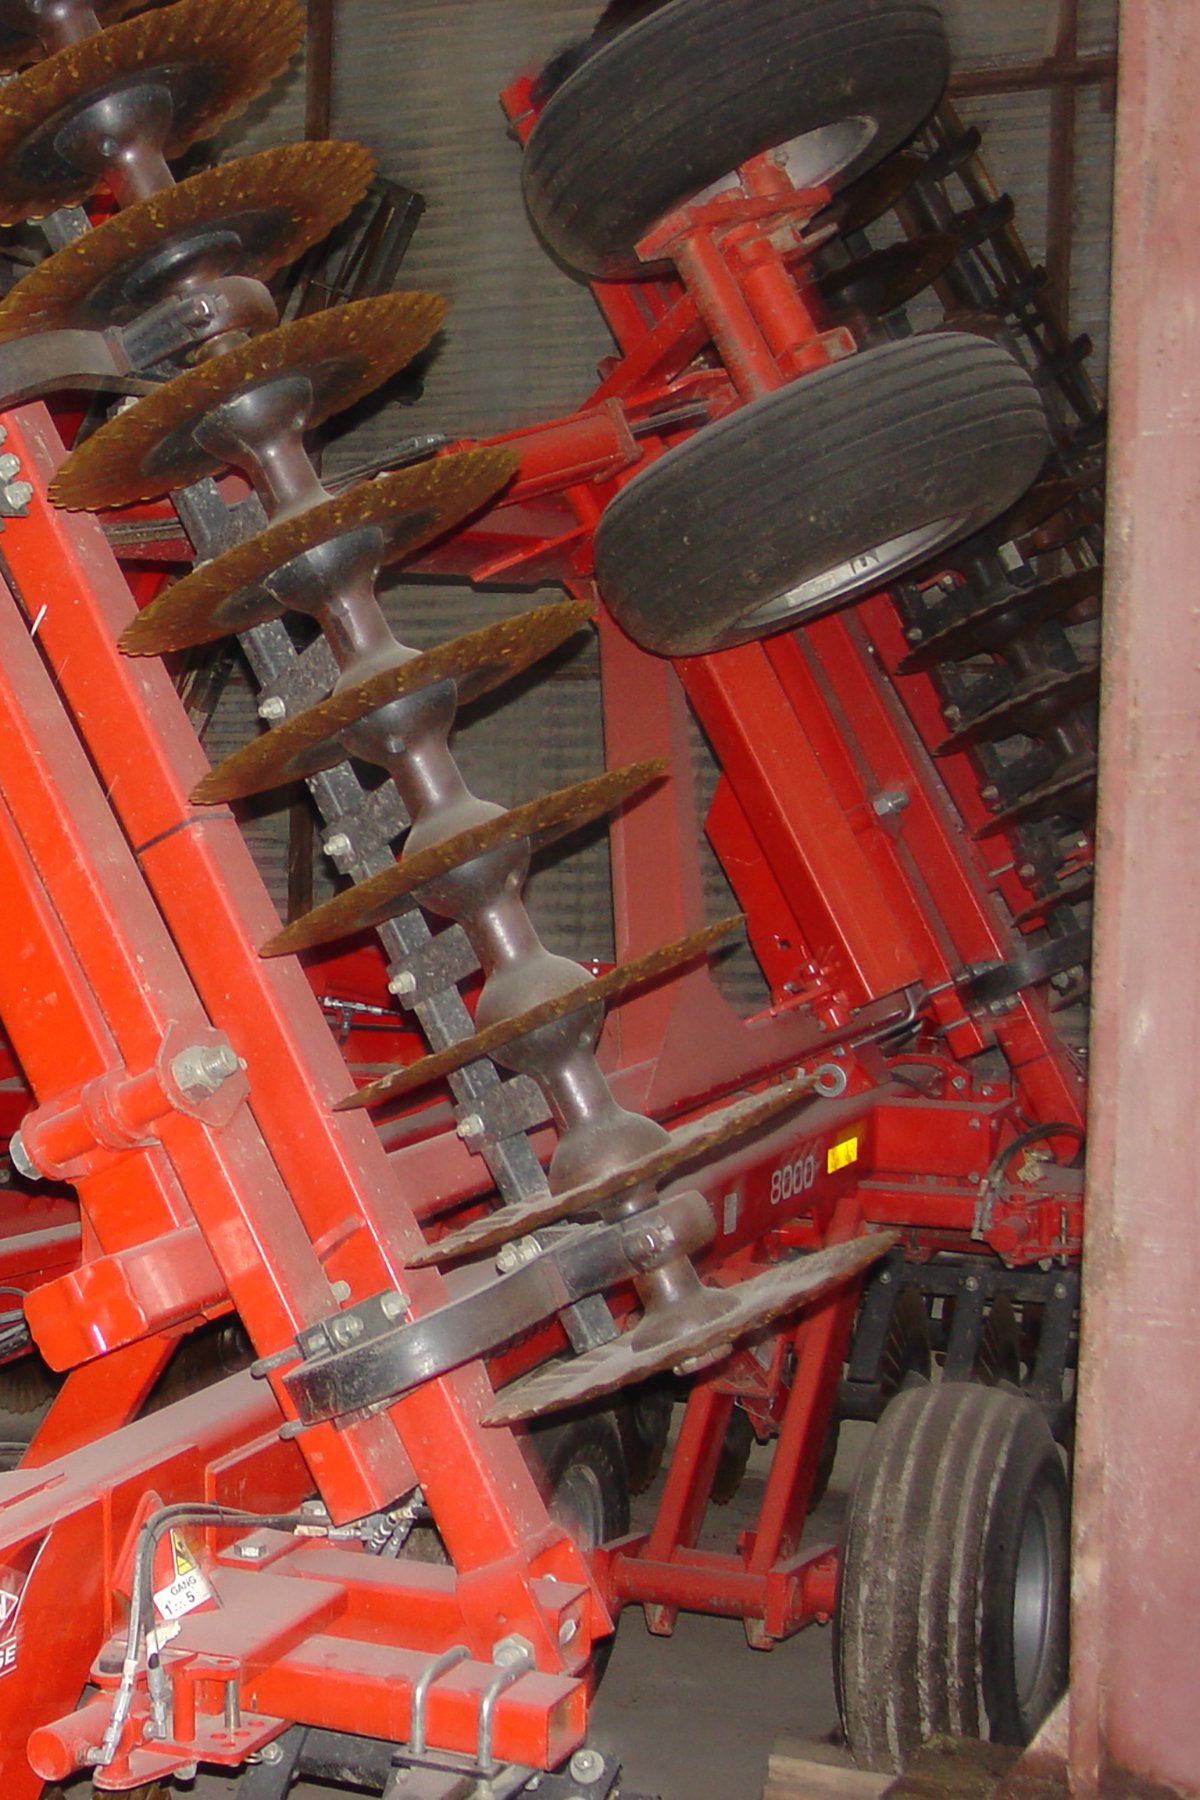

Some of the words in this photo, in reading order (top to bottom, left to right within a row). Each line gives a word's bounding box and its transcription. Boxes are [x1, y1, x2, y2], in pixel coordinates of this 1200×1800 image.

[770, 1155, 814, 1205] 8000
[170, 1576, 197, 1596] GANG
[186, 1590, 195, 1603] 5
